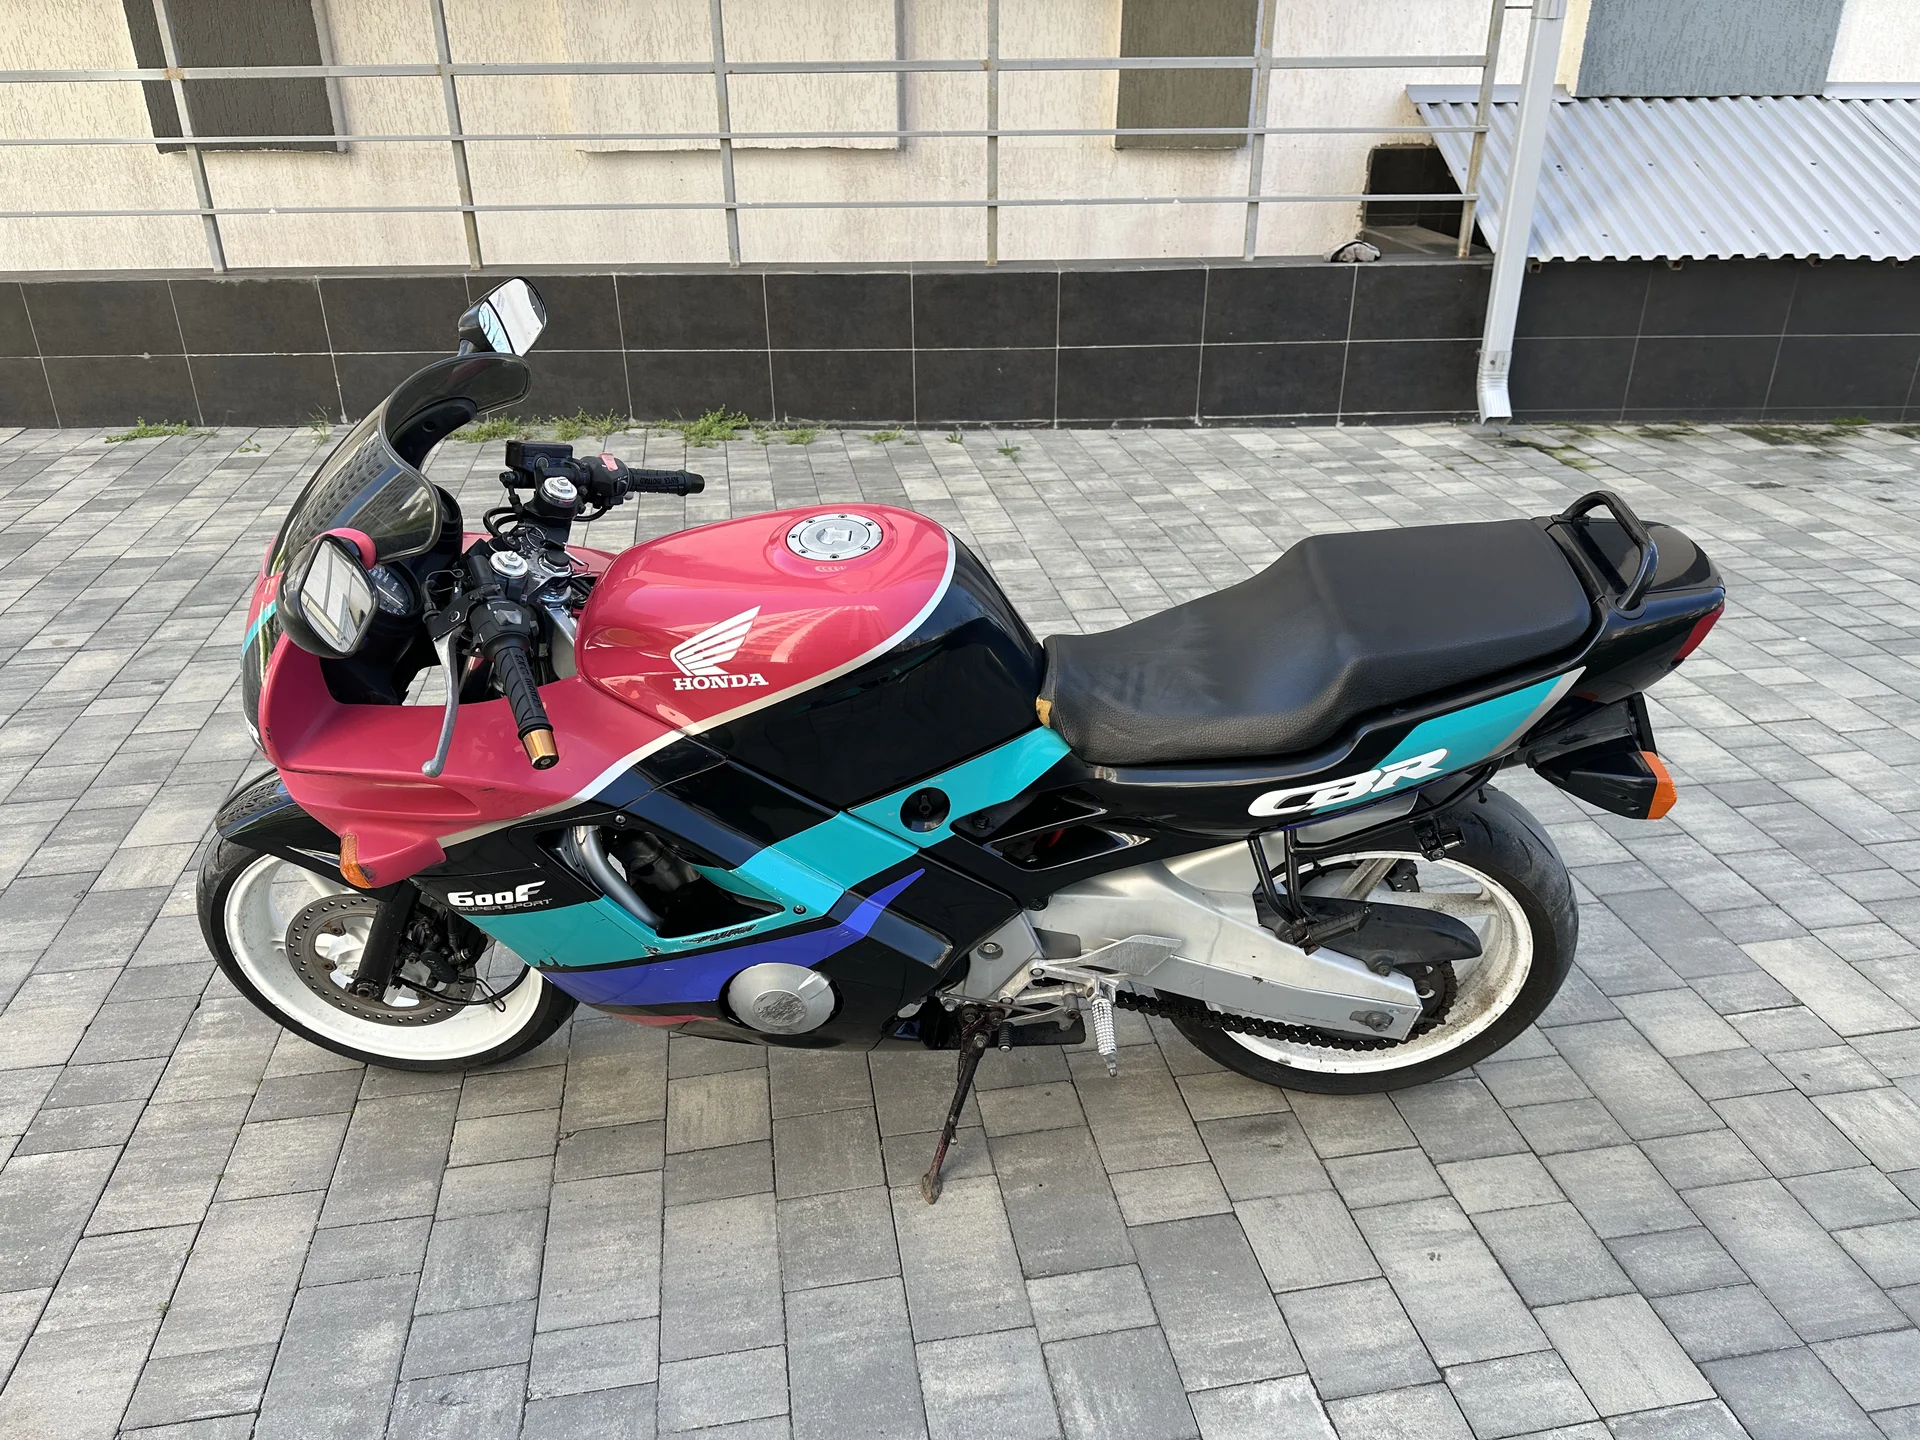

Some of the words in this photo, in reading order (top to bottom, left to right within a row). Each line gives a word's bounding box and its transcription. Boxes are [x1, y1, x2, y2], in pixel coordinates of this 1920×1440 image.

[672, 673, 769, 691] HONDA
[1247, 748, 1449, 817] CBR
[447, 880, 546, 906] 600F
[505, 898, 552, 910] SPORT
